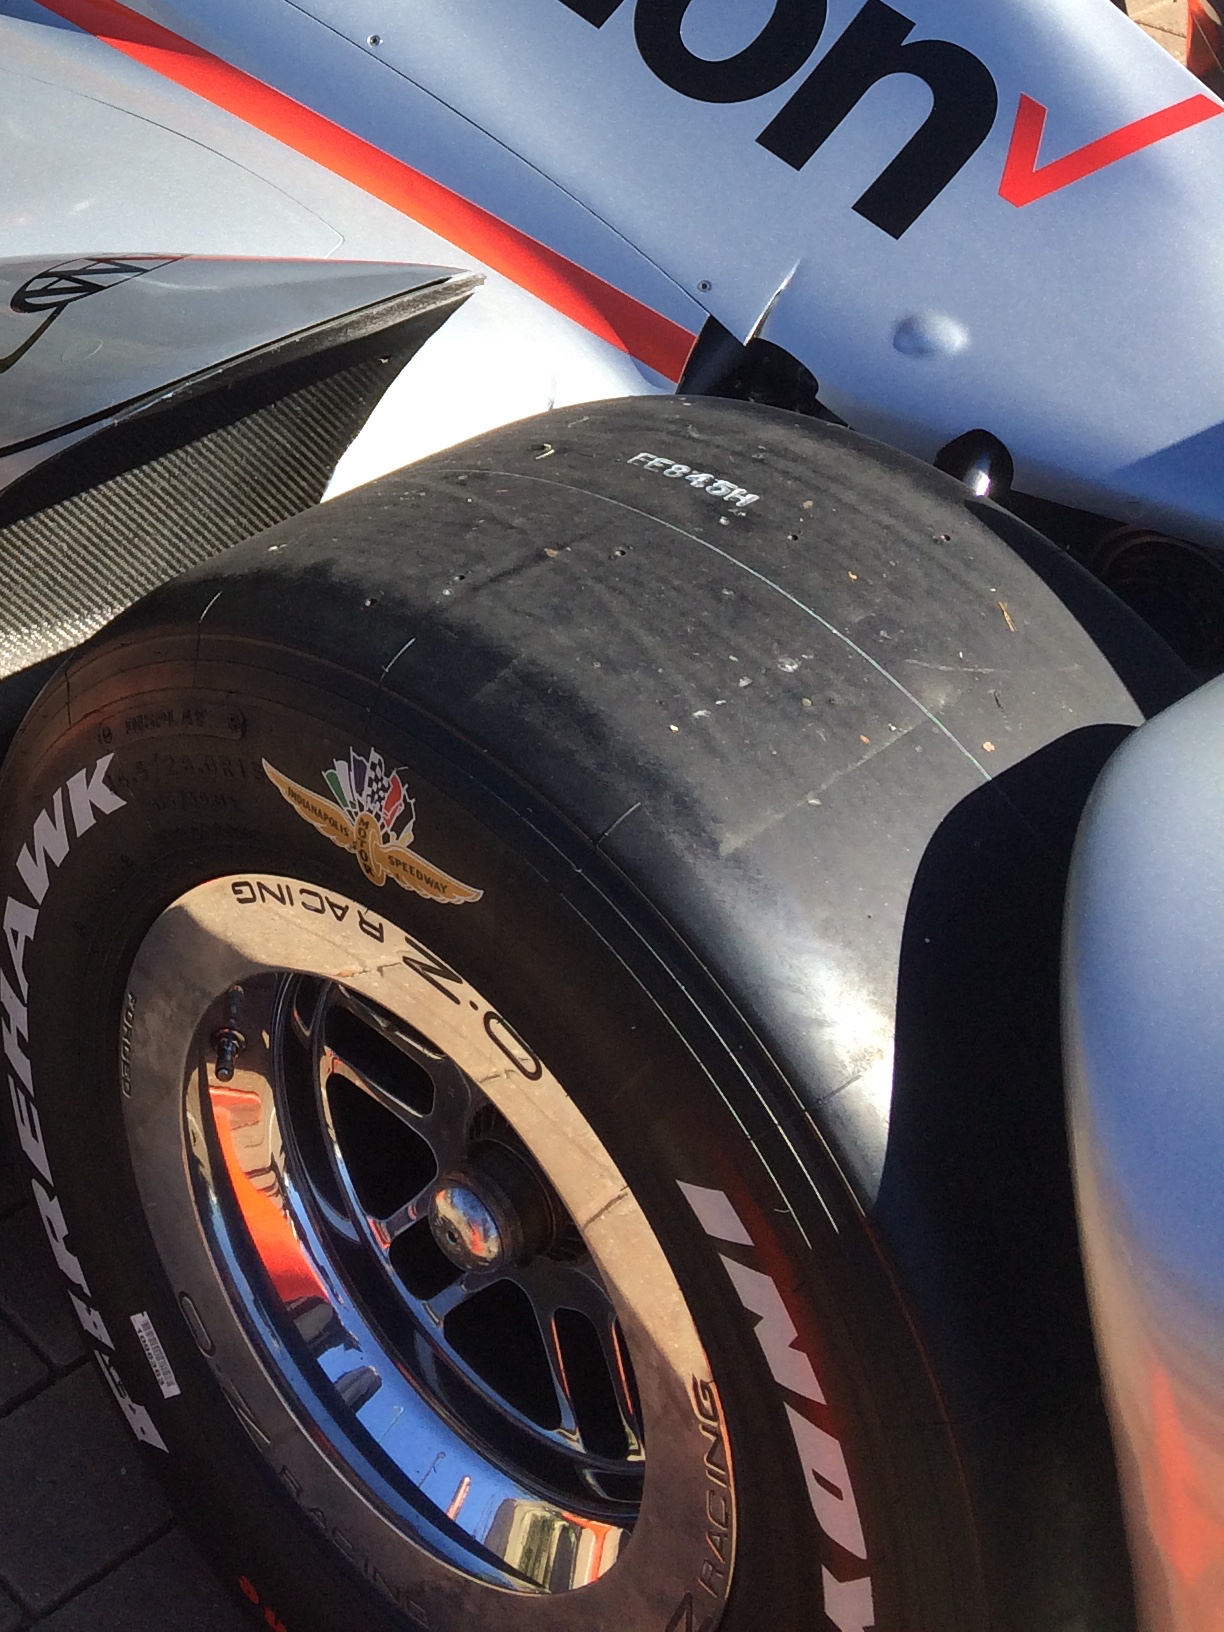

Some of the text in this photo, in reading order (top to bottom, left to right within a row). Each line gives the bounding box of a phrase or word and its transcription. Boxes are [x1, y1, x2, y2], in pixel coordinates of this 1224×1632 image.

[286, 786, 350, 837] INDIANAPOLIS
[356, 817, 375, 877] MOTOR
[387, 854, 448, 894] SPEEDWAY
[231, 880, 385, 944] RACING
[691, 1374, 732, 1599] RACING
